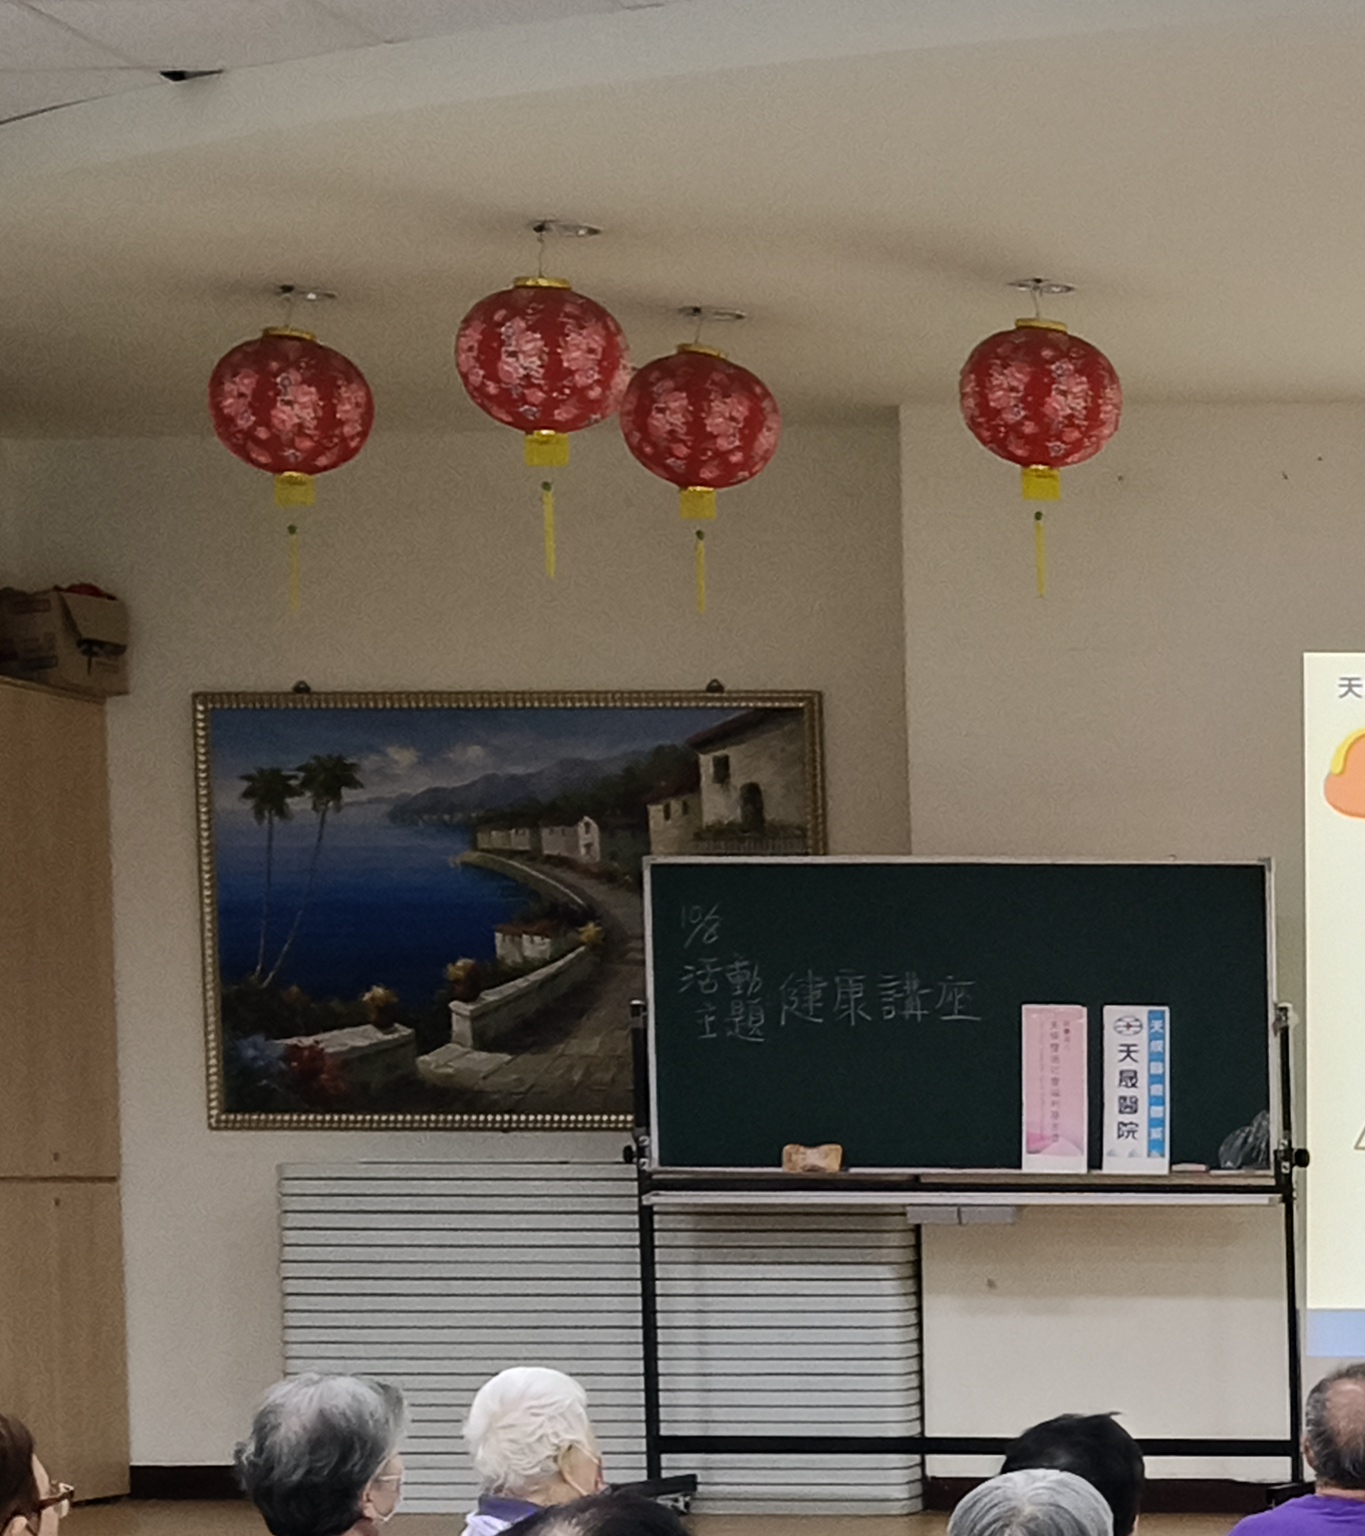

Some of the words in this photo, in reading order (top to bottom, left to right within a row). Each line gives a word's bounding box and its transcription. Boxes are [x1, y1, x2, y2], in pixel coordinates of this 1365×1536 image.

[678, 953, 762, 995] 活動
[779, 966, 983, 1028] 健康講座
[696, 997, 766, 1043] 主題
[1117, 1043, 1141, 1141] 天晟醫院
